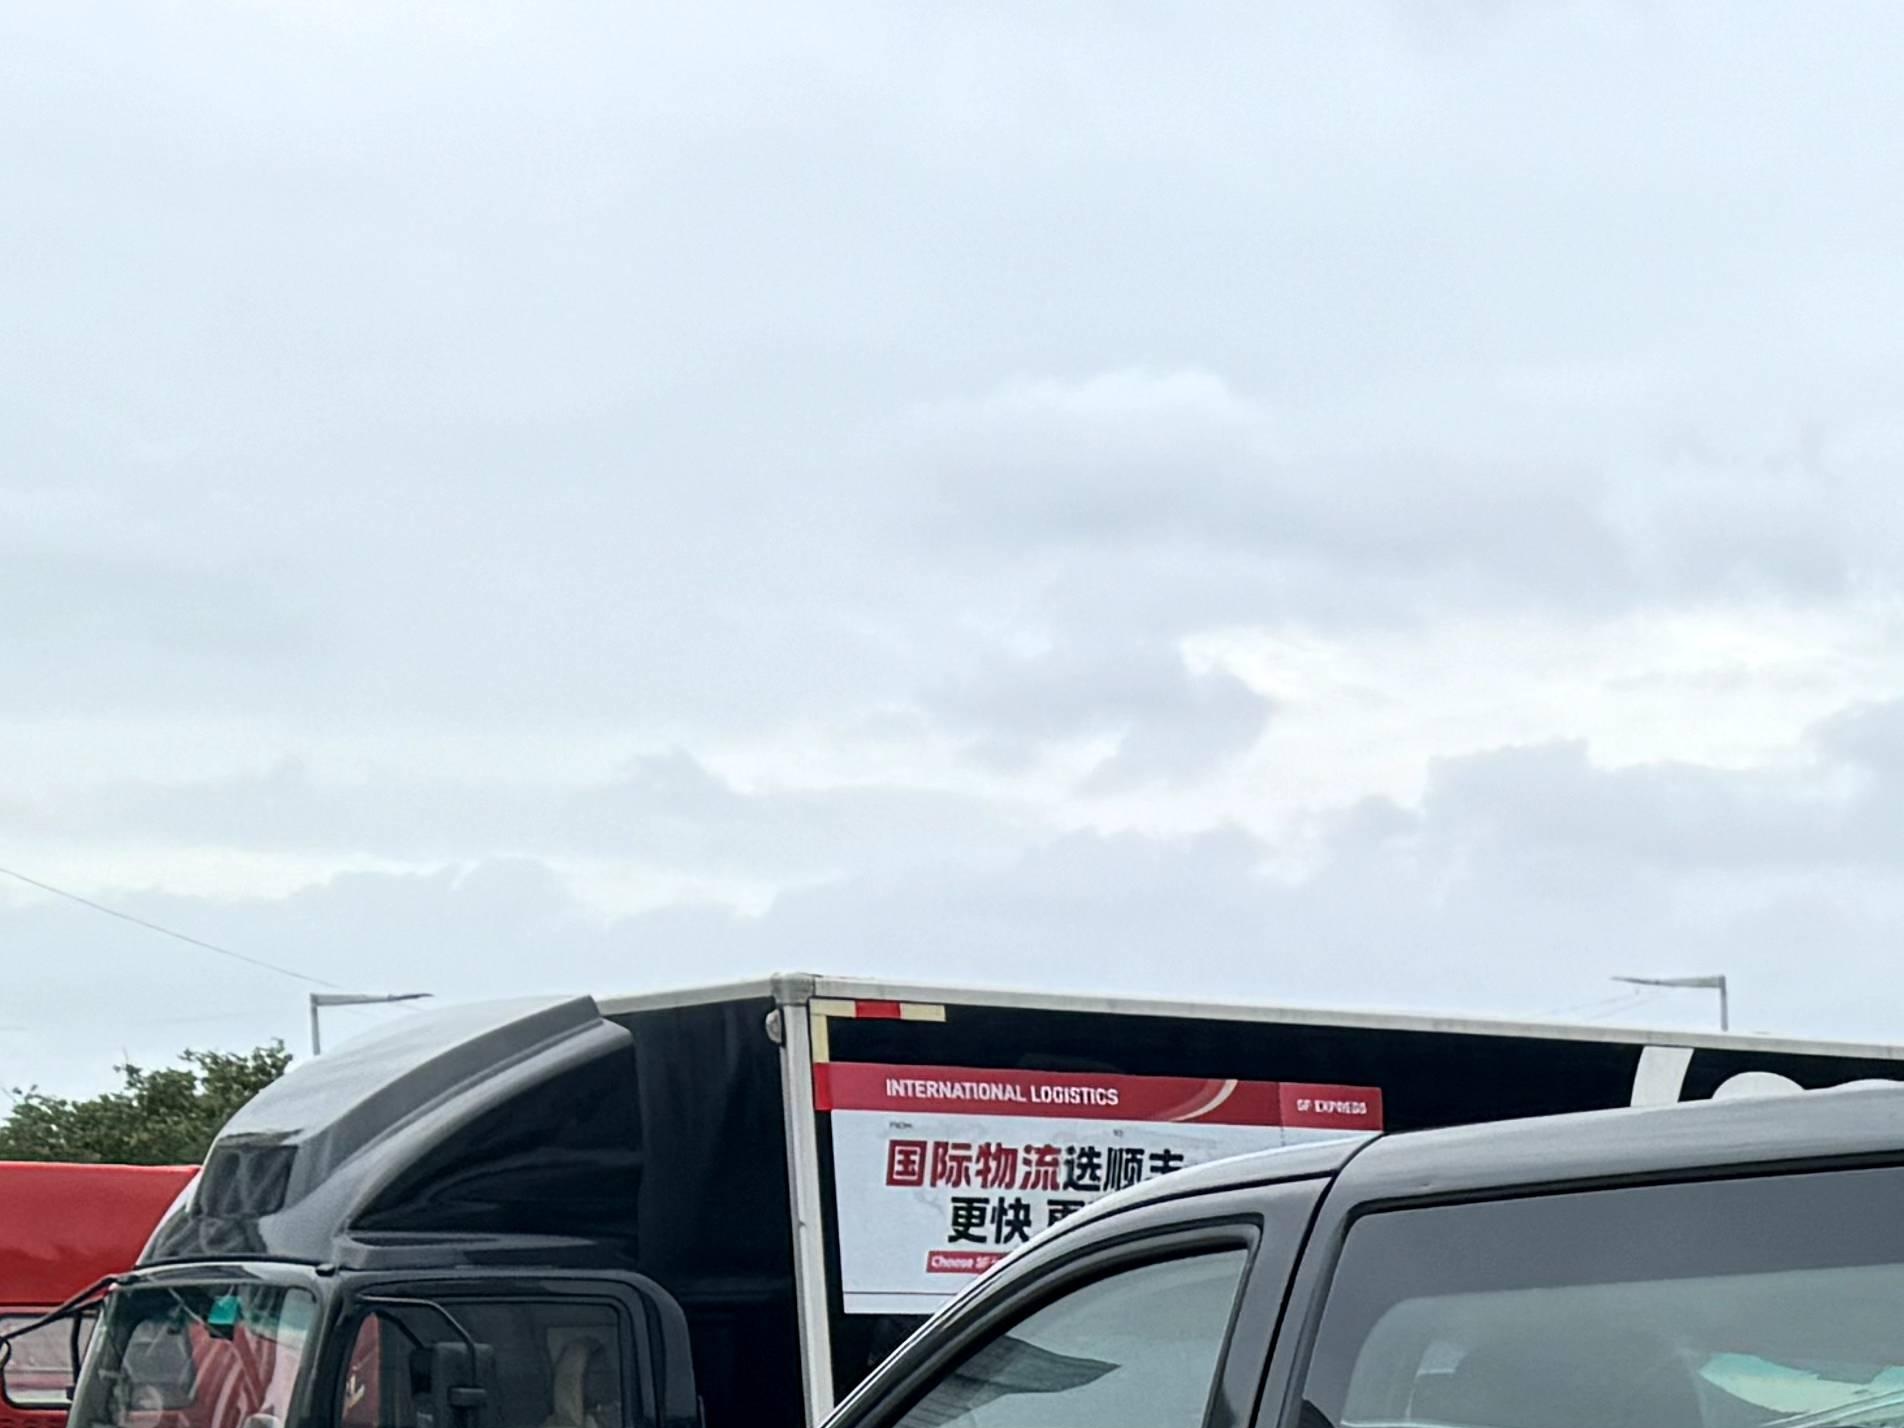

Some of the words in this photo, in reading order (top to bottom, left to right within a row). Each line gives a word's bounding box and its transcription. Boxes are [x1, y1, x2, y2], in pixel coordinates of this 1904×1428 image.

[886, 1079, 1027, 1102] INTERNATIONAL
[1031, 1085, 1119, 1106] LOGISTICS
[948, 1197, 1032, 1244] 更快
